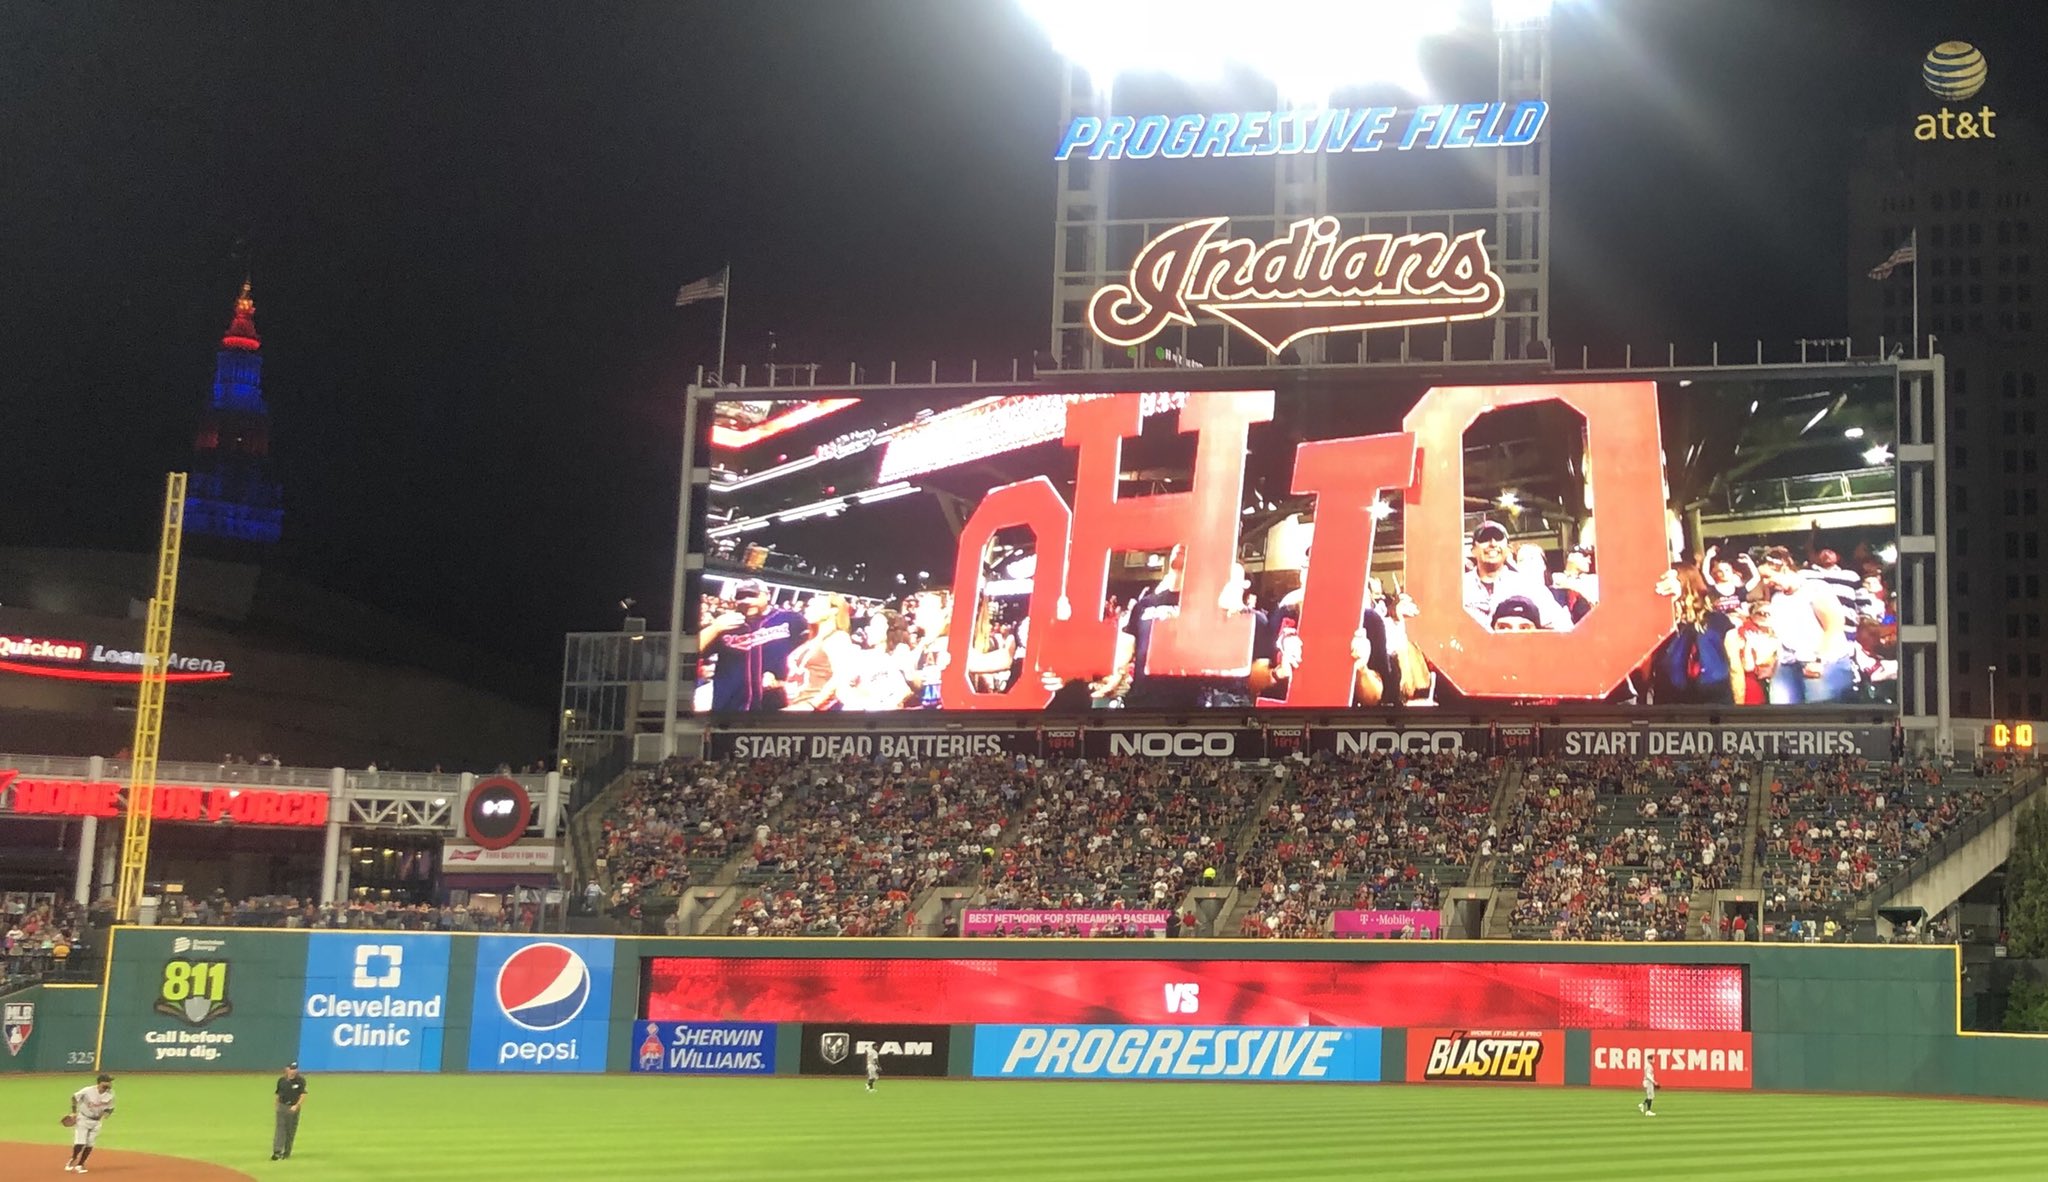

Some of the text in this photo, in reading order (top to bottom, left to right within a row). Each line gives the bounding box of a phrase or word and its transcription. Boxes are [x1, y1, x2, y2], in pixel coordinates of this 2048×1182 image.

[1055, 101, 1549, 160] PROGRESSIVE FIELD
[1914, 106, 1996, 140] at&t
[1089, 215, 1504, 355] Indians
[0, 637, 82, 660] Quicken
[167, 653, 226, 672] Arena
[1273, 729, 1300, 737] NOCO
[1336, 731, 1463, 755] NOCO
[1502, 728, 1531, 736] NOCO
[1566, 731, 1641, 754] START
[1649, 731, 1713, 754] DEAD
[735, 735, 802, 758] START
[811, 735, 872, 758] DEAD
[1110, 733, 1235, 757] NOCO
[13, 780, 122, 816] HOME
[207, 787, 329, 825] PORCH
[969, 914, 993, 924] BEST
[995, 914, 1042, 924] NETWORK
[1044, 914, 1064, 923] FOR
[1065, 914, 1122, 924] STREAMING
[163, 961, 226, 1001] 811
[307, 993, 440, 1018] Cleveland
[1165, 983, 1199, 1013] VS
[5, 1005, 32, 1020] MLB
[145, 1031, 234, 1044] Call before
[333, 1023, 411, 1047] Clinic
[672, 1025, 763, 1046] SHERWIN
[67, 1052, 95, 1065] 325
[156, 1046, 221, 1060] you dig.
[500, 1038, 577, 1064] pepsi
[855, 1040, 932, 1056] RAM
[1002, 1028, 1342, 1077] PROGRESSIVE
[1427, 1038, 1540, 1076] BLASTER
[1595, 1047, 1744, 1071] CRAFTSMAN
